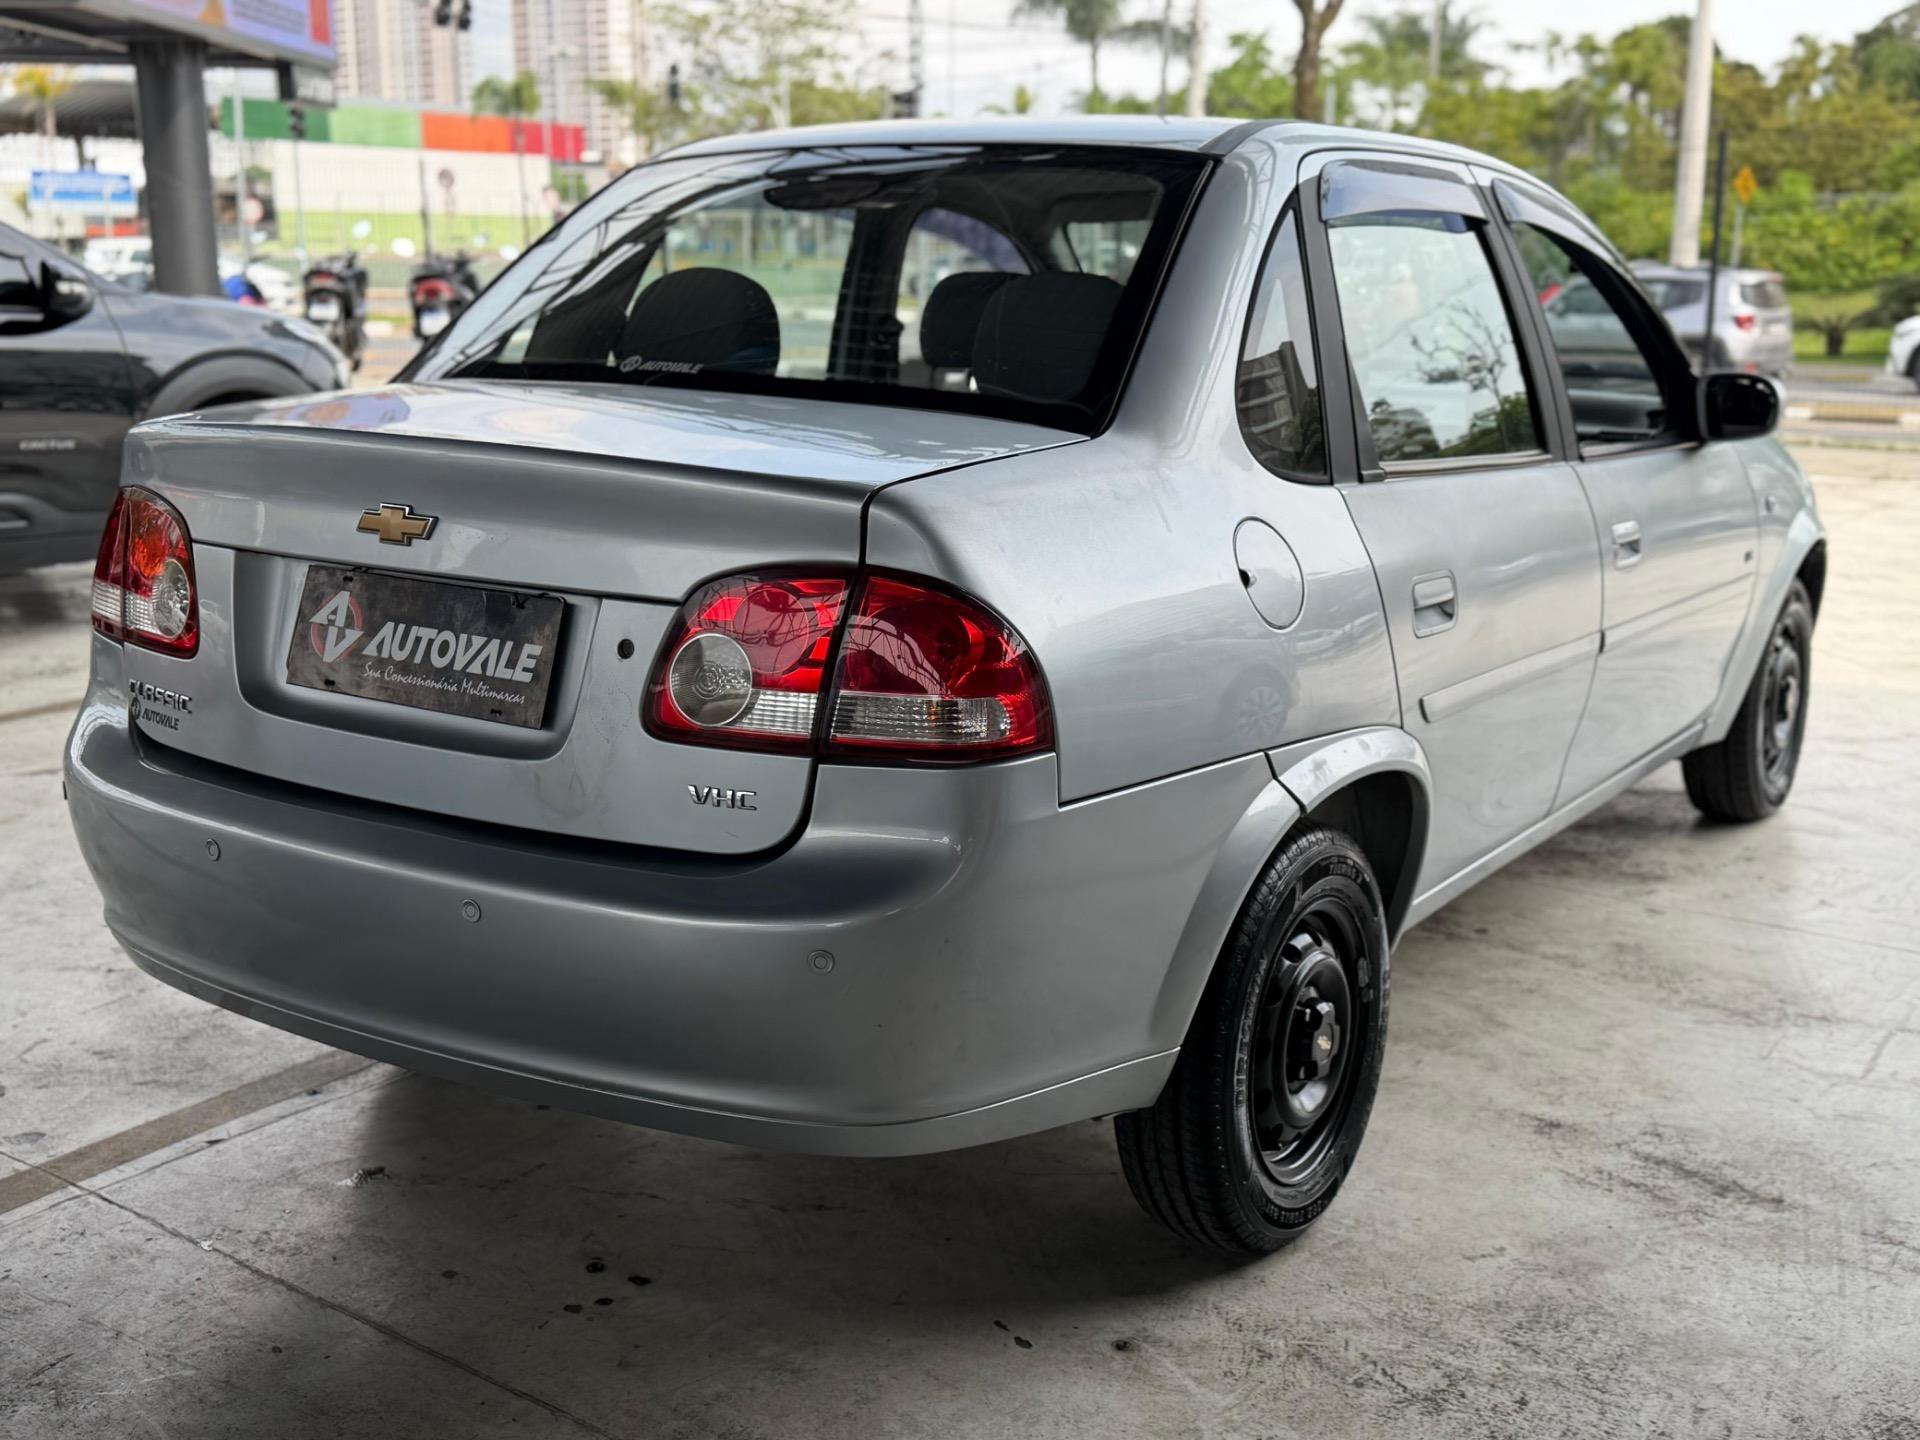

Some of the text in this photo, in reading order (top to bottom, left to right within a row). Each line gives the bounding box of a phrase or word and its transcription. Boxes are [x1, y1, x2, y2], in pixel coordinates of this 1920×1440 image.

[362, 621, 544, 684] AUTOVALE
[128, 678, 192, 714] CLASSIC
[363, 661, 525, 704] Sua Concessionária Multimarcas
[142, 708, 180, 731] AUTOVALE
[688, 783, 757, 811] VHC
